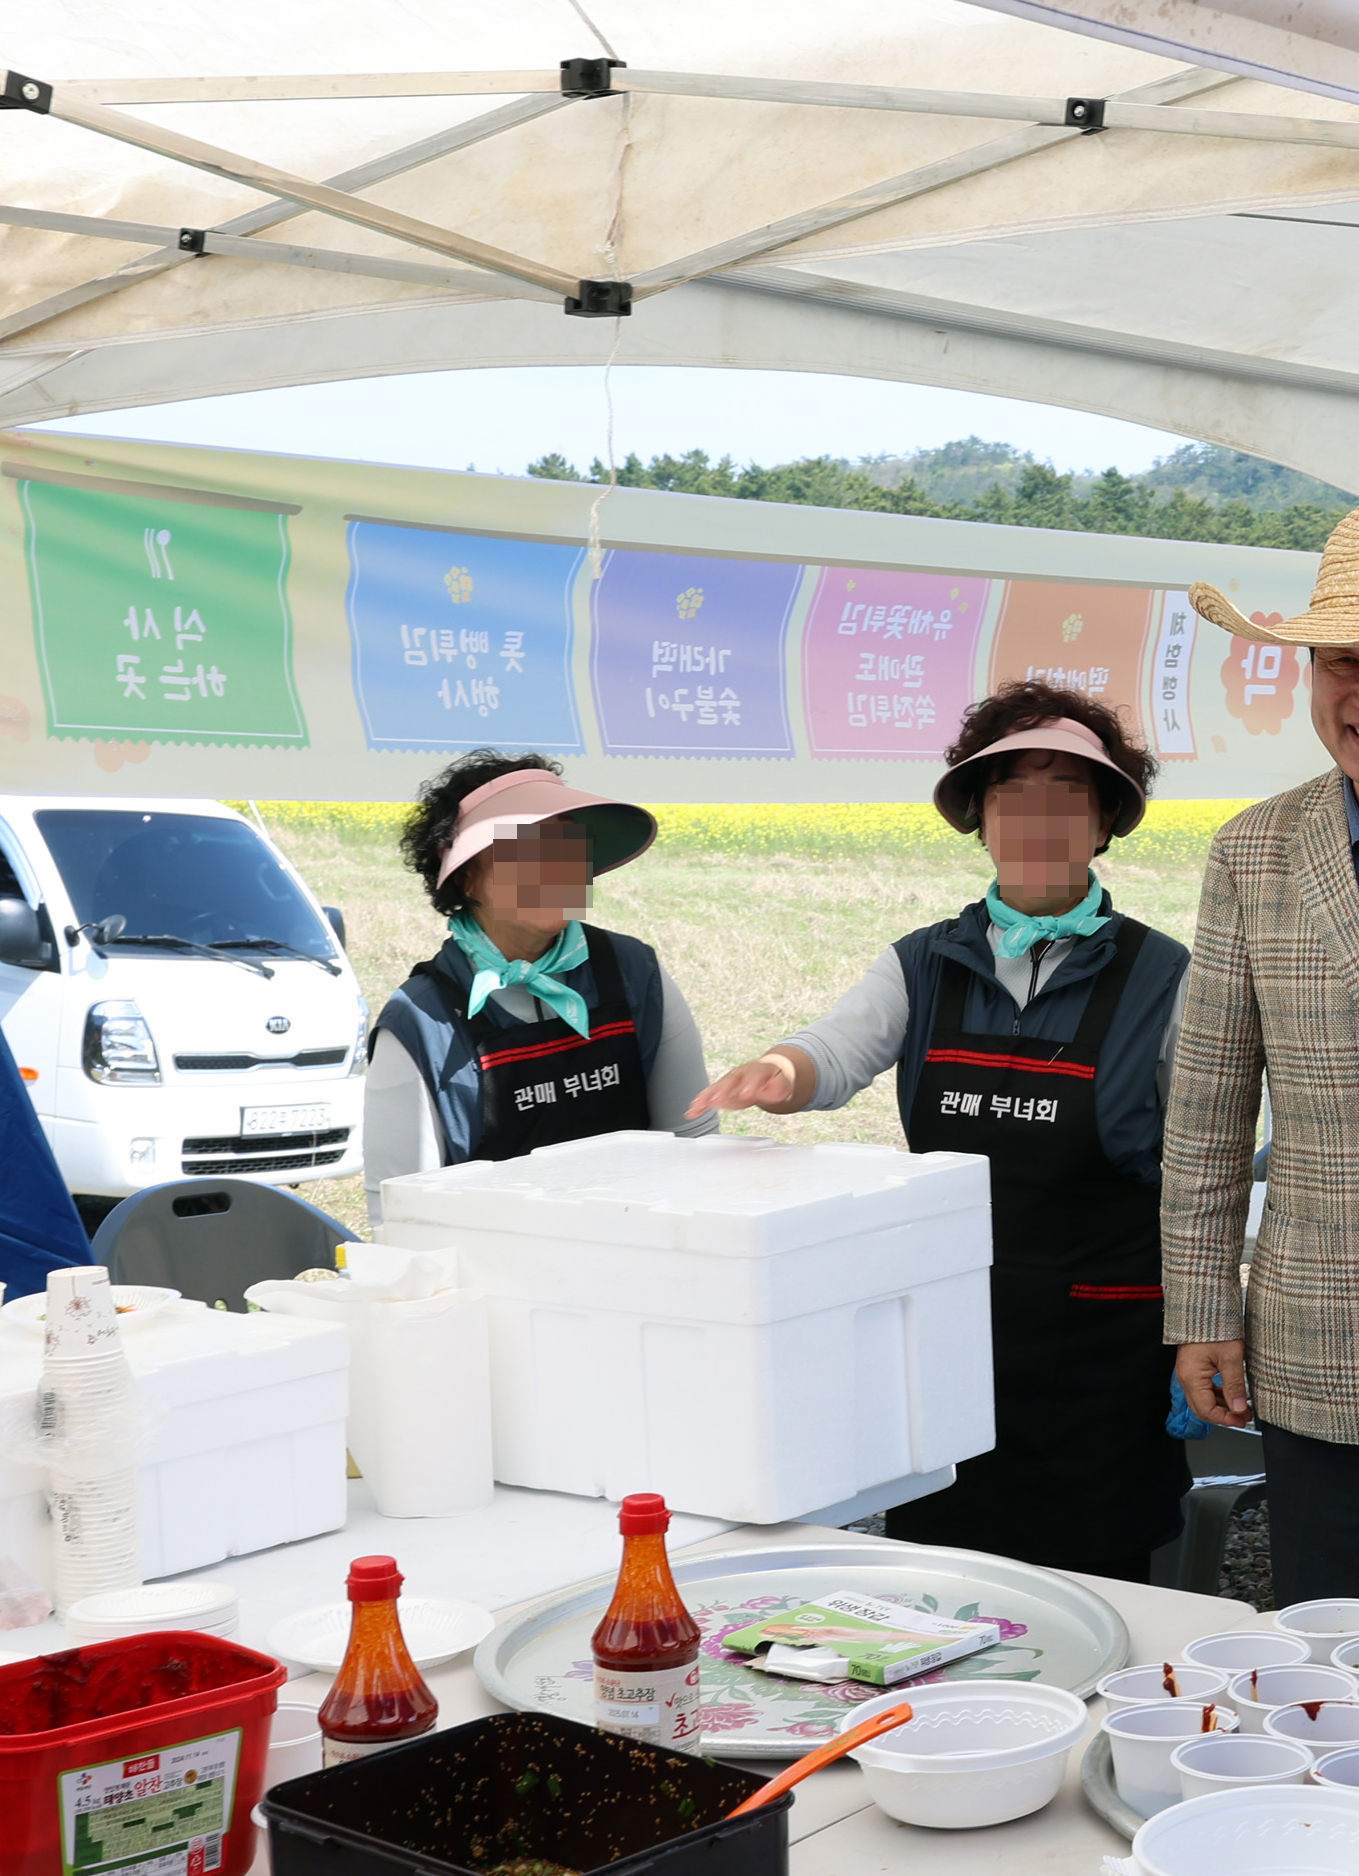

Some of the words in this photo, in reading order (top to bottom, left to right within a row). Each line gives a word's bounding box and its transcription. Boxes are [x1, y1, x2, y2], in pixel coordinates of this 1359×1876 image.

[268, 1018, 290, 1032] KIA
[514, 1081, 557, 1111] 관매
[563, 1063, 620, 1098] 부녀회
[940, 1091, 983, 1117] 관매
[989, 1094, 1059, 1123] 부녀회
[828, 1599, 890, 1622] 위생장갑
